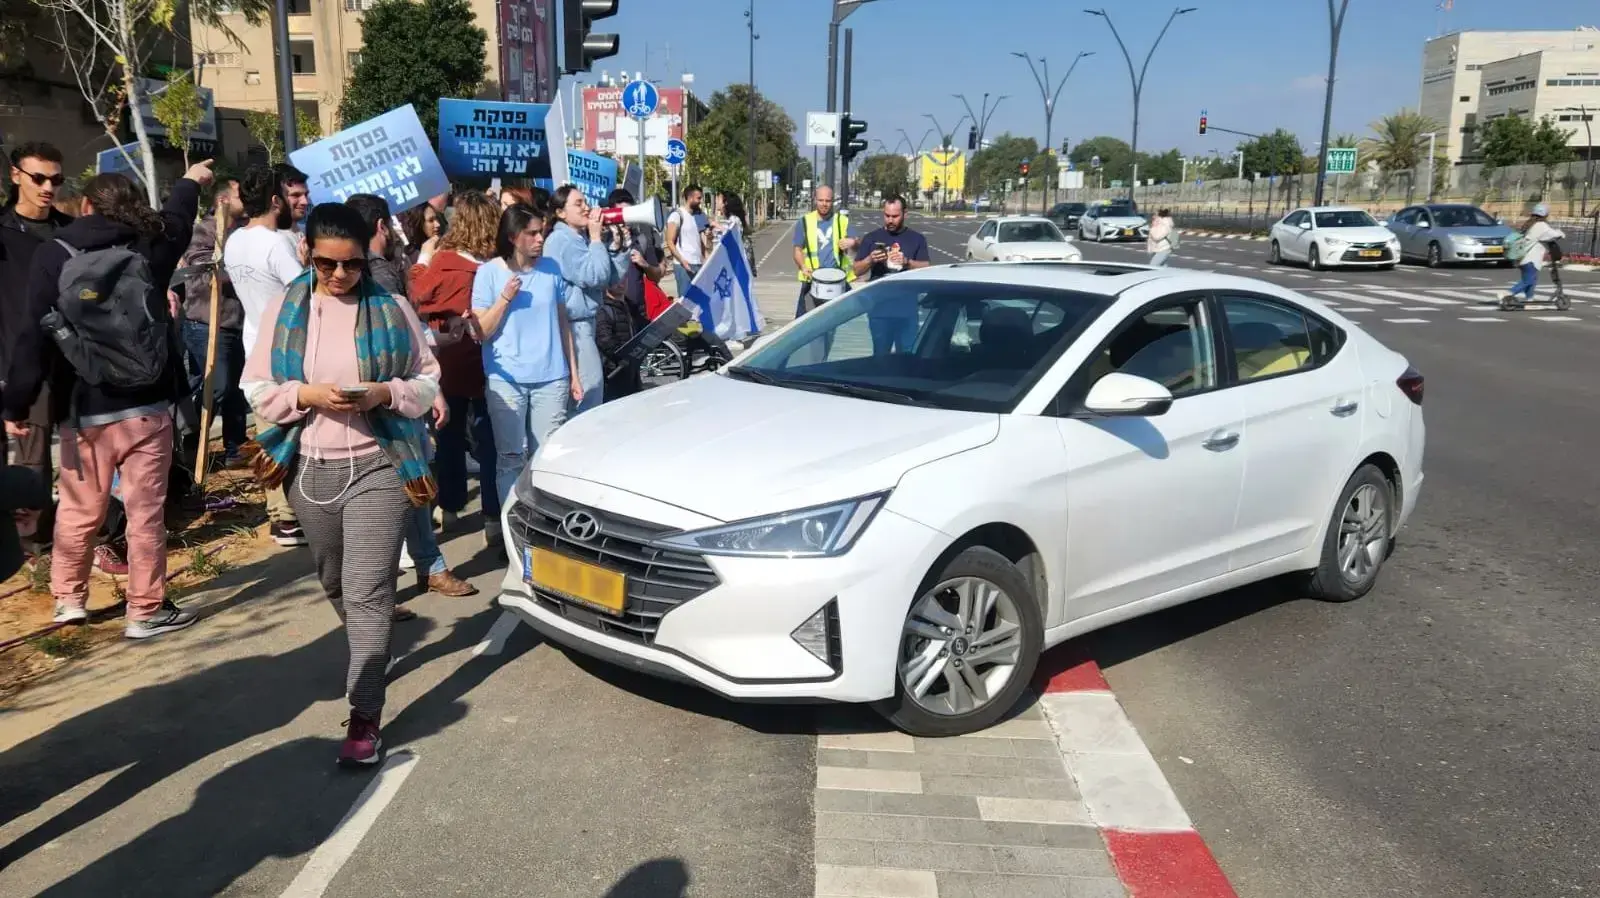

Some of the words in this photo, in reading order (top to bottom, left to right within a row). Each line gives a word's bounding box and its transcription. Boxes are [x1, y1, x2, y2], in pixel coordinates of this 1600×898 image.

[473, 108, 527, 125] פסקת
[447, 124, 545, 141] ההתגברות-
[328, 125, 389, 161] פסקת
[459, 140, 512, 156] נתגבר
[516, 141, 541, 158] לא
[313, 136, 418, 189] ההתגברות-
[393, 155, 423, 181] לא
[472, 158, 499, 172] זה!
[503, 158, 528, 173] על
[569, 166, 610, 188] ההתגבר
[388, 180, 420, 205] על
[592, 185, 607, 199] לא
